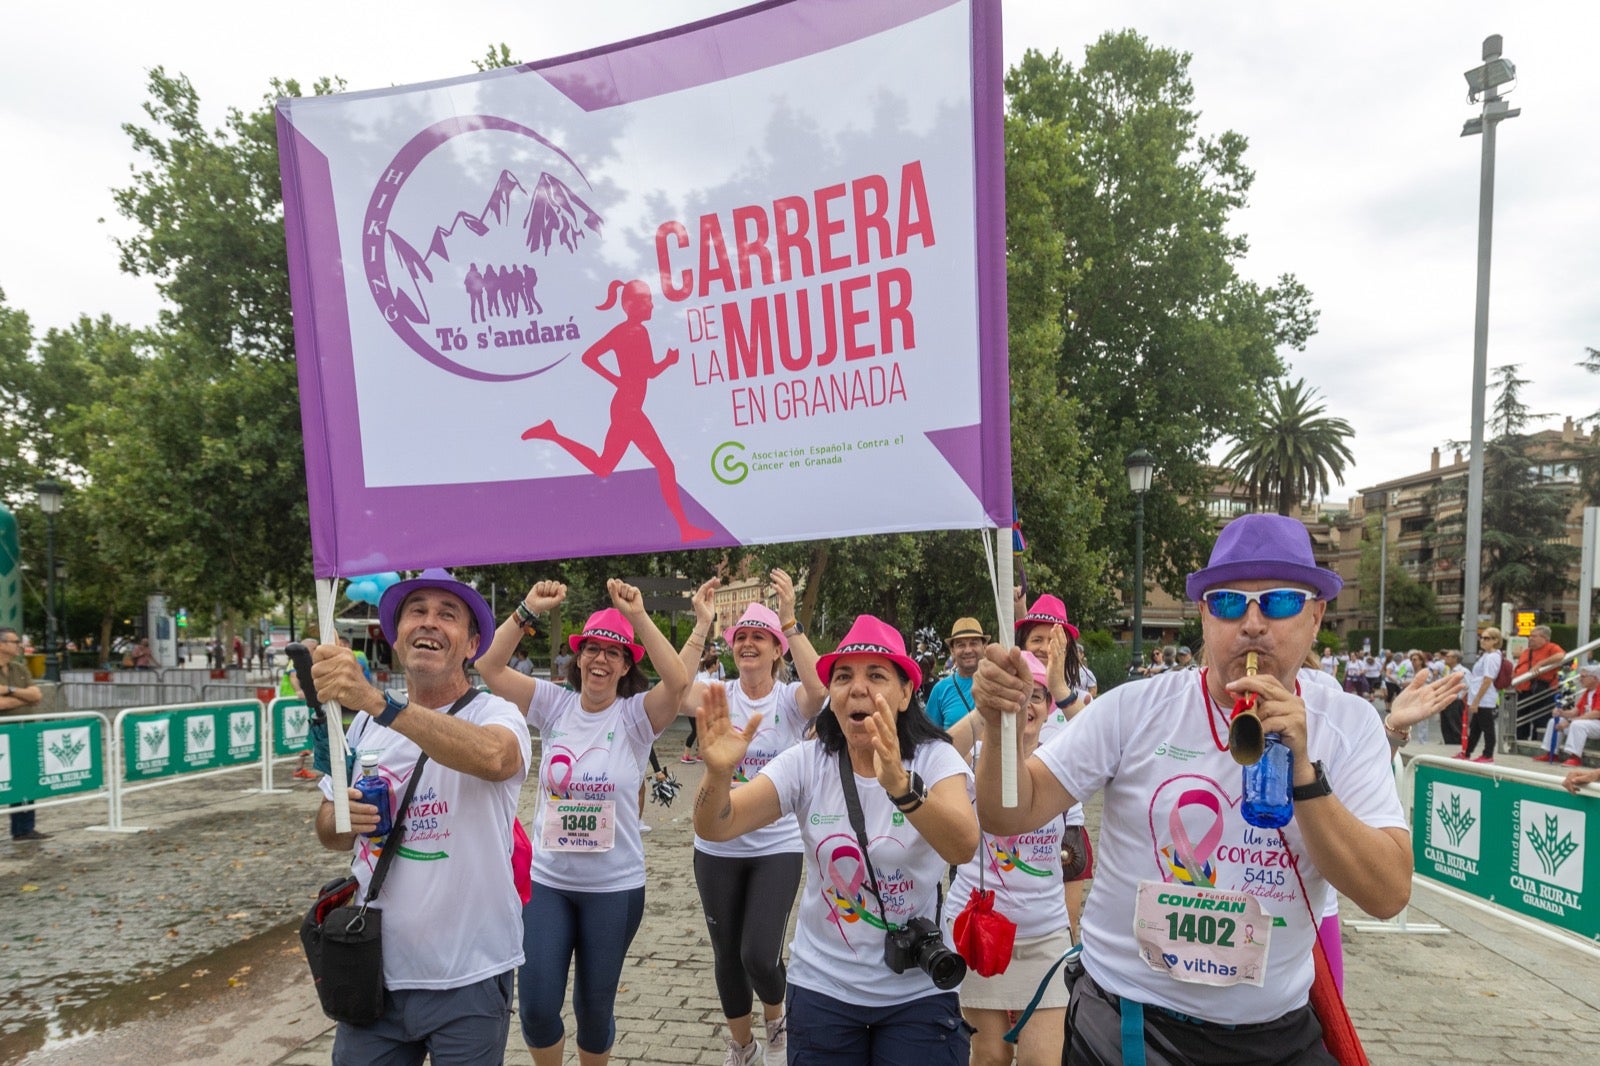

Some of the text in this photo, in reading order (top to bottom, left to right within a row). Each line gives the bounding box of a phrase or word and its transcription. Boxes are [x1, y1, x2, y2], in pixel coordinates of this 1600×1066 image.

[655, 160, 936, 302] CARRERA
[367, 168, 404, 322] HIKING
[435, 316, 581, 351] Tó s'andará
[686, 305, 718, 343] DE
[721, 267, 916, 381] MUJER
[691, 350, 725, 386] LA
[732, 362, 908, 426] EN GRANADA
[752, 434, 904, 460] Asociación Española Contra el
[752, 455, 843, 471] Cáncer en Granada
[744, 758, 772, 766] cora
[569, 782, 615, 793] corazón
[406, 800, 449, 819] razón
[557, 805, 602, 813] COVIRAN
[1424, 783, 1433, 845] fundación
[411, 817, 438, 832] 5415
[561, 815, 597, 831] 1348
[570, 837, 598, 846] vithas
[1243, 828, 1264, 845] Un
[1510, 801, 1521, 872] fundación
[1033, 845, 1053, 854] 5415
[1424, 847, 1479, 876] CAJA RURAL
[1243, 867, 1285, 885] 5415
[1434, 864, 1467, 882] GRANADA
[1157, 893, 1246, 913] COVIRAN
[1509, 875, 1582, 911] CAJA RURAL
[1522, 895, 1565, 917] GRANADA
[1165, 911, 1236, 948] 1402
[1183, 958, 1238, 976] vithas
